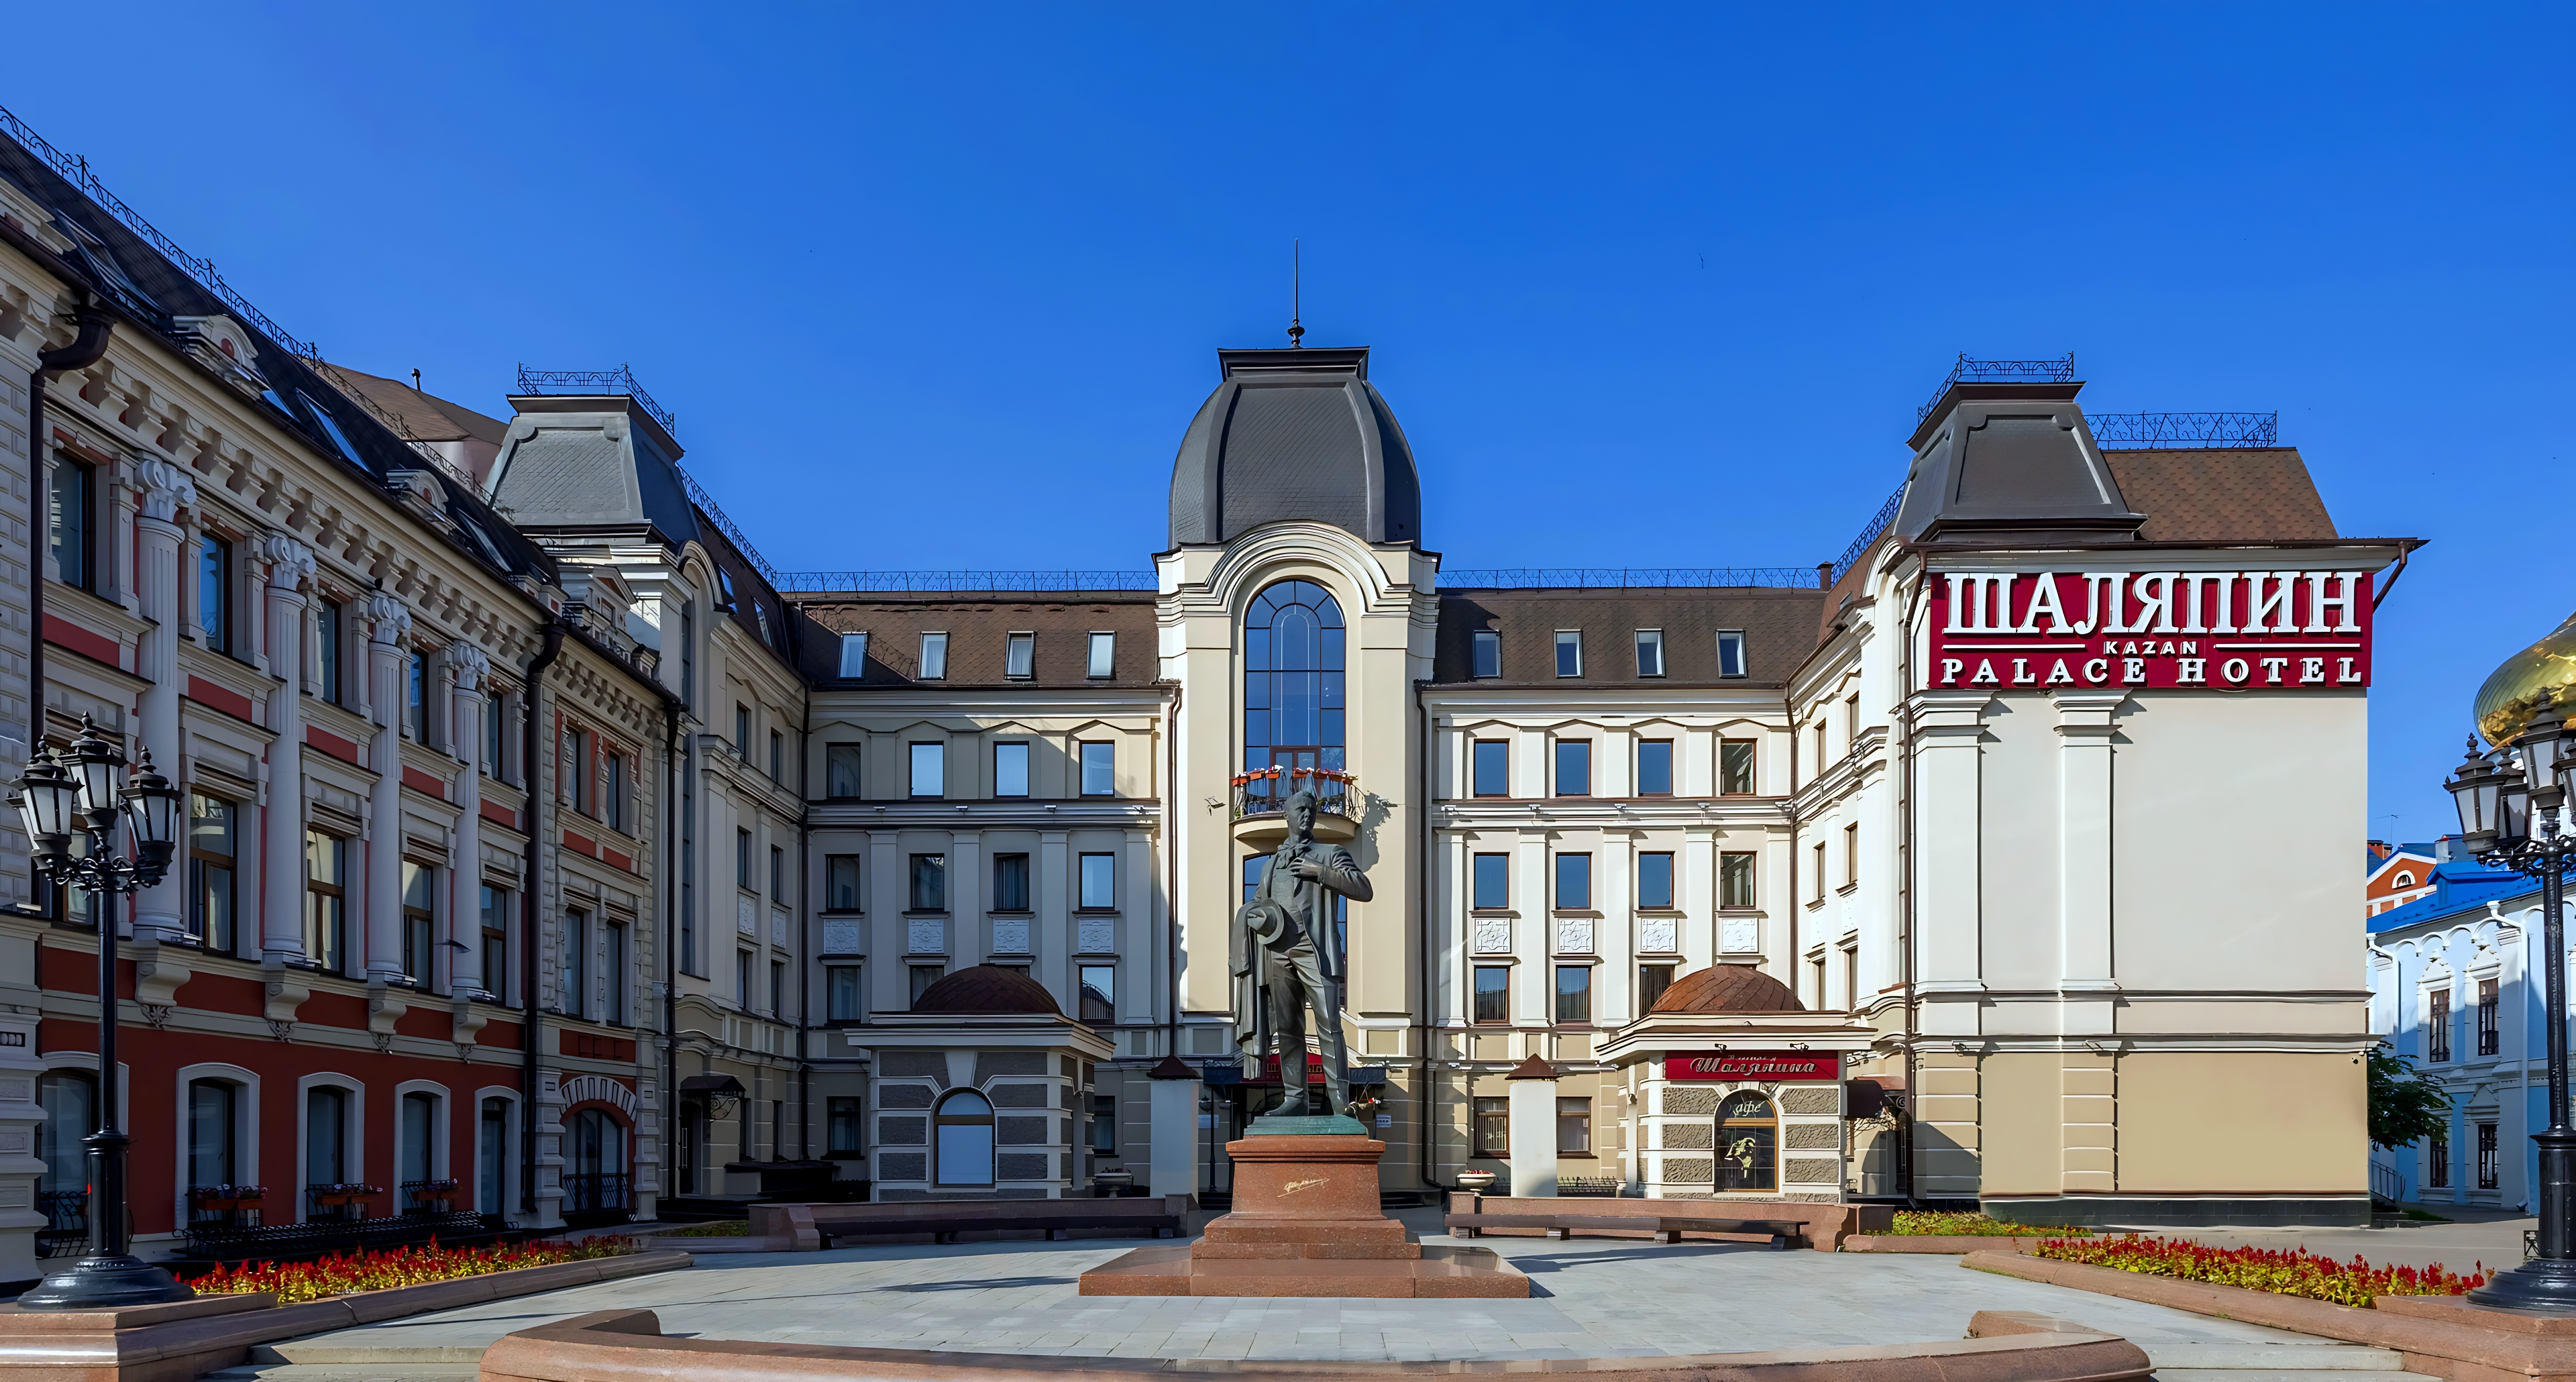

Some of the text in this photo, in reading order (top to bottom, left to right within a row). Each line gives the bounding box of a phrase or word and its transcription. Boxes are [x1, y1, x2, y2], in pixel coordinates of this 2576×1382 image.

[1942, 572, 2362, 635] ШАЛЯПИН
[2104, 641, 2197, 655] KAZAN
[1941, 657, 2362, 684] PALACE HOTEL
